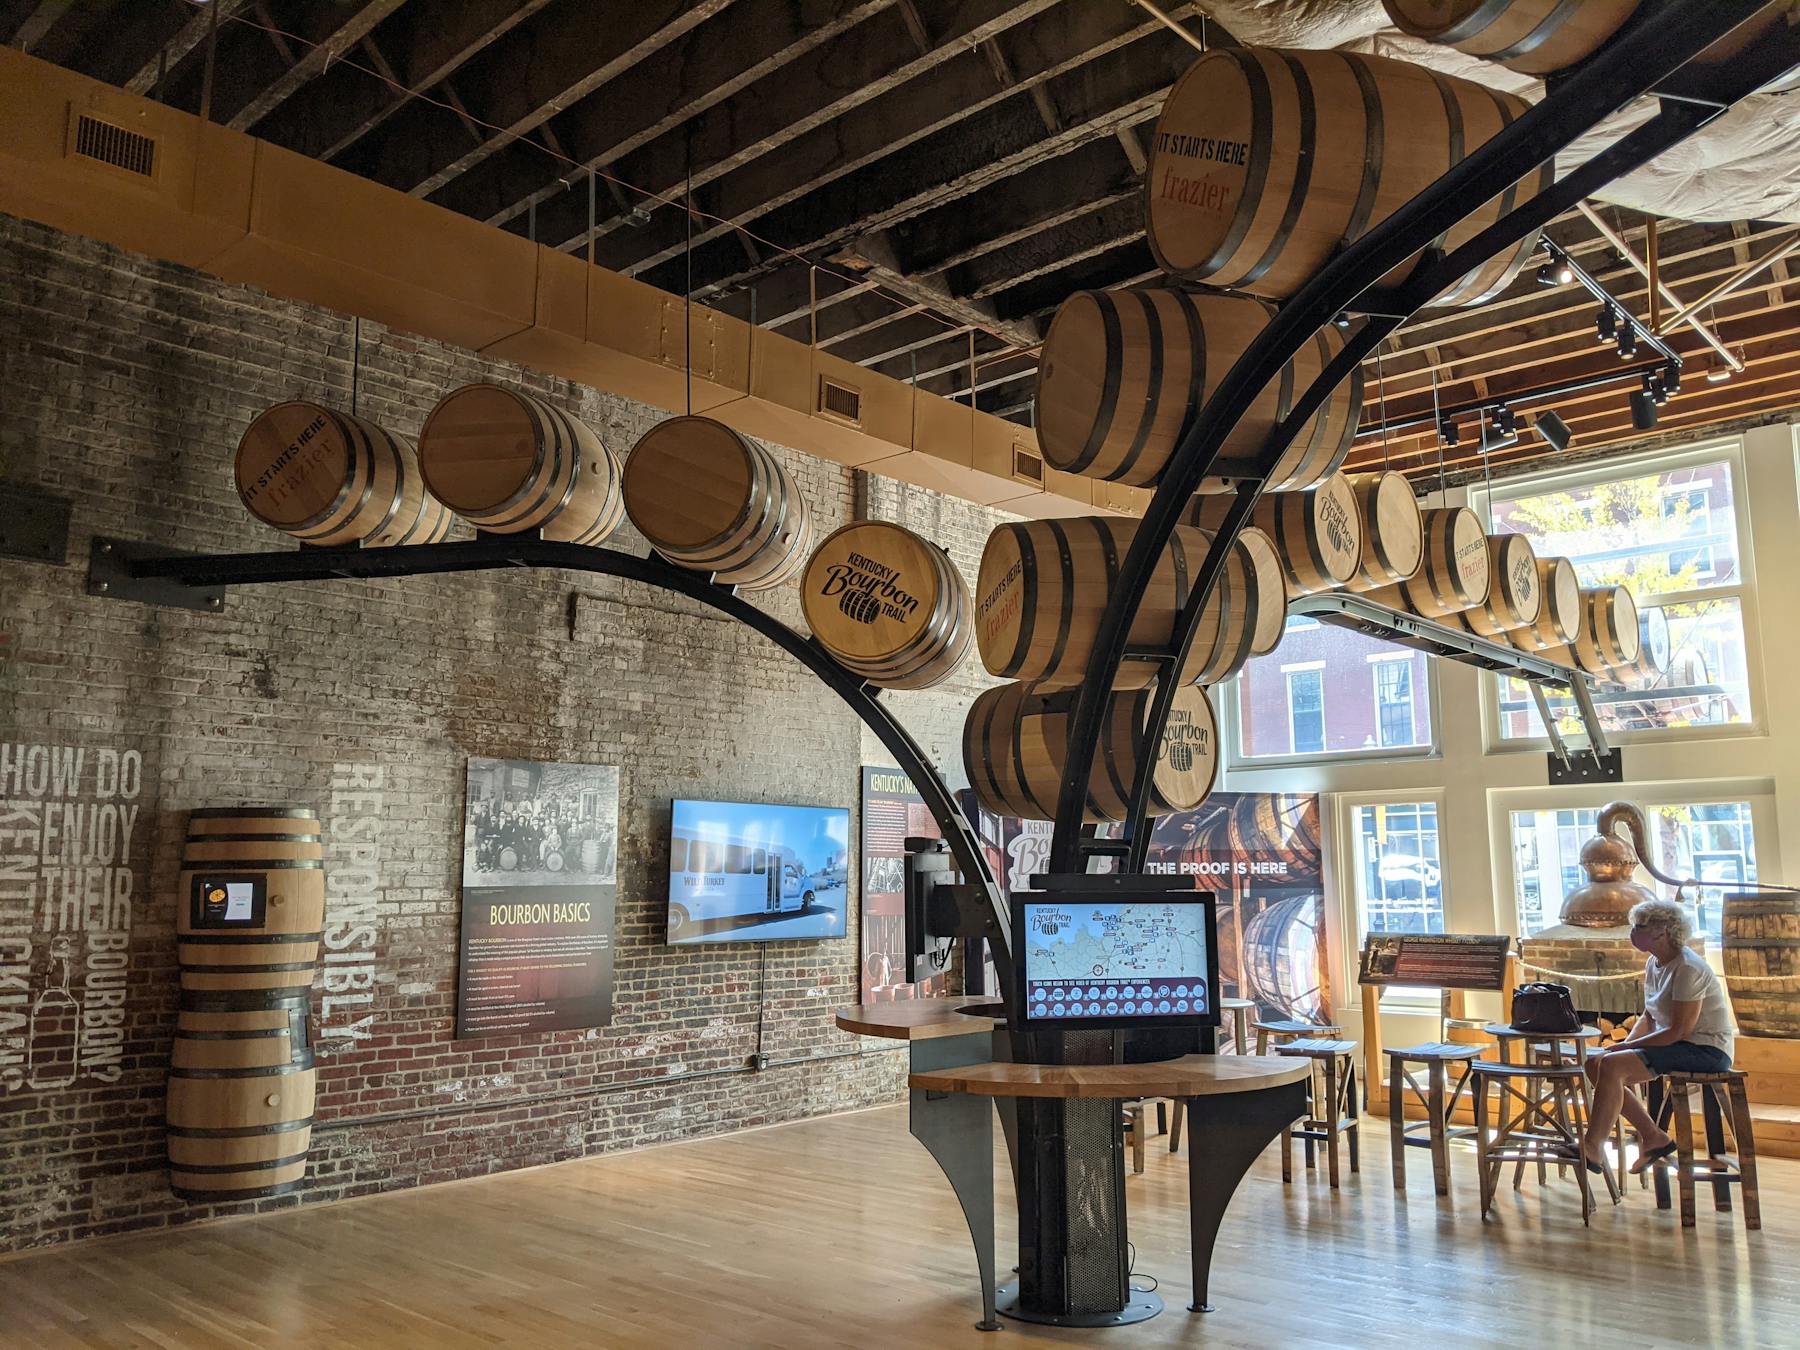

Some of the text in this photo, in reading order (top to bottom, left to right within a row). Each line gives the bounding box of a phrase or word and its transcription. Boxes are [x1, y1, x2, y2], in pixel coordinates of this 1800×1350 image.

[1158, 133, 1248, 166] IT STARTS HERE
[1160, 166, 1230, 212] frazier
[245, 416, 327, 500] IT STARTS HERE
[1320, 496, 1355, 553] Bourbon
[847, 551, 894, 579] KENTUCKY
[985, 578, 1007, 612] STARTS
[1006, 559, 1022, 587] HERE
[821, 564, 919, 615] Bourbon
[881, 602, 906, 624] TRAIL
[986, 591, 1020, 641] frazier
[0, 743, 142, 799] HOW DO
[1192, 742, 1207, 755] TRAIL
[42, 802, 139, 865] ENJOY
[1027, 821, 1054, 834] KENT
[1147, 862, 1287, 874] THE PROOF IS HERE
[41, 867, 133, 932] THEIR
[490, 902, 591, 925] BOURBON BASICS
[1030, 907, 1071, 931] Bourbon
[81, 933, 129, 1083] BOURBON?
